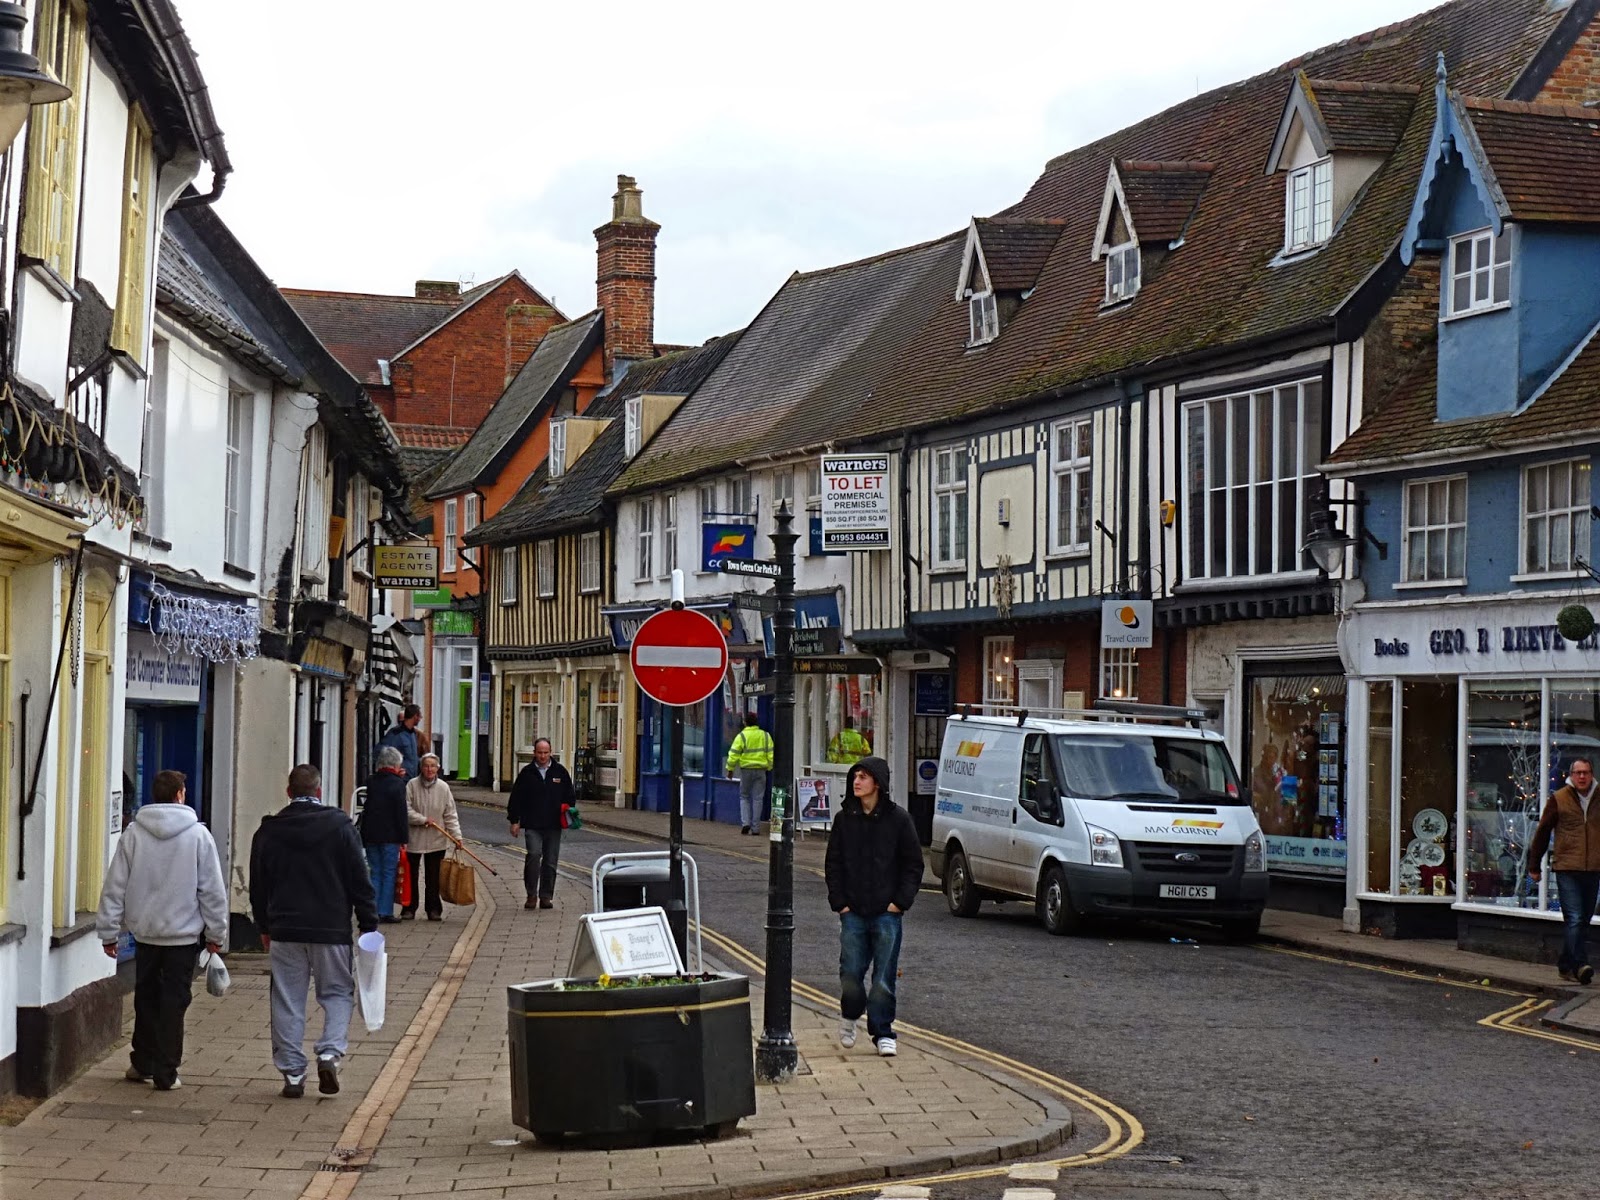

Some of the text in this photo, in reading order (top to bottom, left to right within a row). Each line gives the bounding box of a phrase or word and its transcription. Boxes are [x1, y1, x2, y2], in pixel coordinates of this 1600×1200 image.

[825, 459, 886, 471] warners
[828, 476, 883, 490] TO LET
[827, 492, 884, 500] COMMERCIAL
[834, 500, 877, 508] PREMISES
[856, 533, 884, 541] 604431
[381, 552, 432, 560] ESTATE
[380, 563, 433, 571] AGENTS
[727, 560, 739, 570] Town
[740, 561, 754, 572] Green
[754, 562, 762, 573] Car
[762, 564, 773, 575] Park
[381, 577, 431, 586] warners
[1105, 634, 1149, 643] Travel Centre
[1374, 637, 1410, 656] Books
[943, 758, 955, 773] MAY
[1171, 826, 1218, 836] GURNEY
[1265, 840, 1283, 855] Travel
[1284, 841, 1305, 857] Centre
[1168, 885, 1208, 897] HG11 CXS
